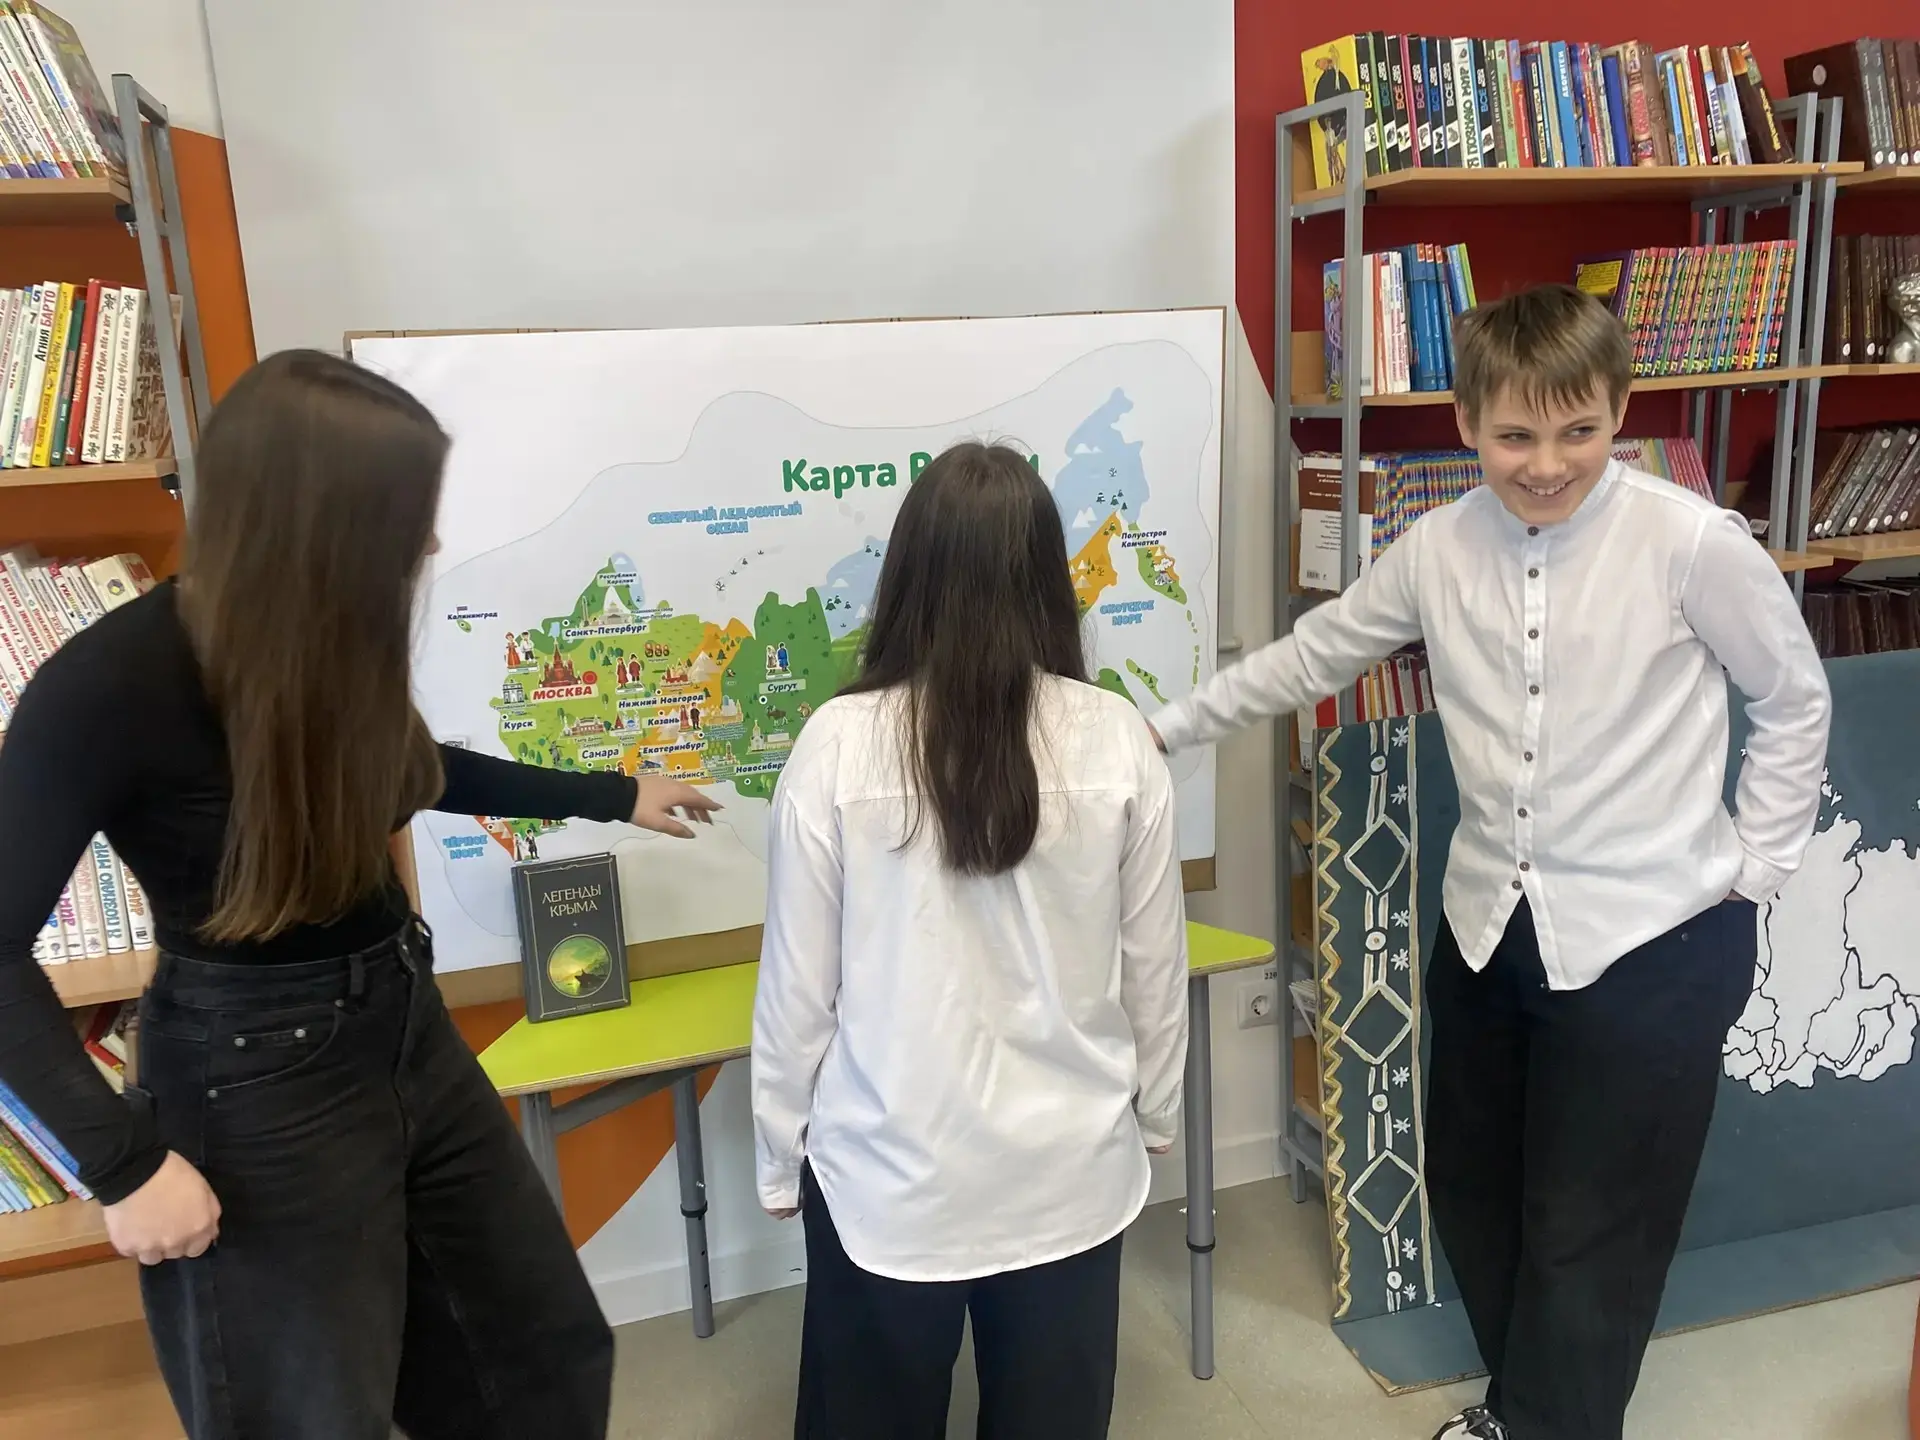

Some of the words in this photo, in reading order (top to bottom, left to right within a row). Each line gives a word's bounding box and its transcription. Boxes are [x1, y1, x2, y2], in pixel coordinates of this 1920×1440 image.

[1459, 67, 1471, 96] МИР
[1463, 100, 1478, 155] ПОЗНАЮ
[1468, 157, 1479, 167] Я
[33, 290, 41, 302] 5
[40, 290, 56, 328] БАРТО
[29, 312, 38, 325] 7
[782, 459, 896, 498] Карта
[648, 506, 717, 524] СЕВЕРНЫЙ
[718, 501, 802, 520] ЛЕДОВИТЫЙ
[706, 521, 748, 535] ОКЕАН
[1121, 529, 1167, 540] Полуостров
[1121, 538, 1159, 548] Камчатка
[1100, 600, 1154, 614] ОХОТСКОЕ
[447, 611, 498, 621] Калининград
[1112, 612, 1142, 626] МОРЕ
[565, 624, 647, 638] Санкт-Петербург
[1, 632, 31, 682] РИКЛЮЧЕНИЯ
[533, 686, 592, 700] МОСКВА
[767, 683, 797, 693] Сургут
[618, 697, 657, 709] Нижний
[660, 694, 704, 706] Новгород
[504, 721, 533, 730] Курск
[647, 717, 680, 727] Казань
[582, 749, 619, 759] Самара
[643, 740, 705, 755] Екатеринбург
[736, 761, 786, 773] Новосибир
[442, 835, 487, 849] ЧЁРНОЕ
[94, 841, 111, 869] МИР
[450, 847, 483, 859] МОРЕ
[99, 872, 120, 926] ПОЗНАЮ
[542, 884, 602, 904] ЛЕГЕНДЫ
[126, 887, 144, 916] МИР
[550, 900, 598, 917] КРЫМА
[106, 928, 121, 939] Я
